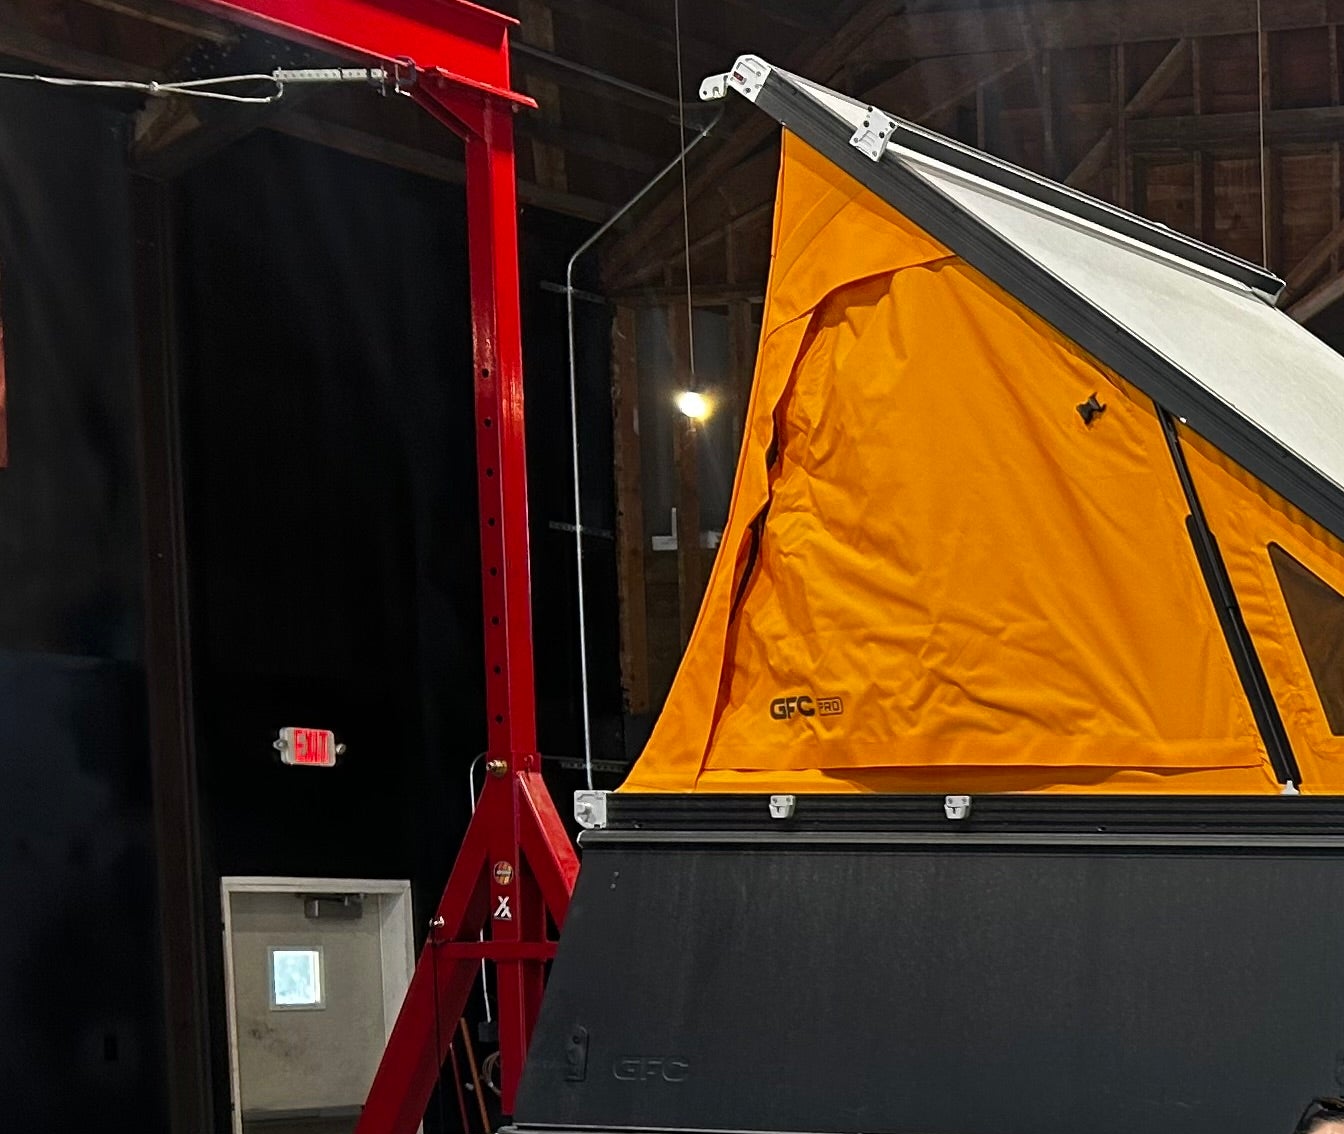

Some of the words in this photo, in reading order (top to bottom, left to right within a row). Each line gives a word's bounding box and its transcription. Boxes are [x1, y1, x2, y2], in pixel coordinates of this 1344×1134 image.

[769, 695, 816, 721] GFC
[818, 699, 842, 715] PRO
[294, 729, 330, 763] EXIT
[612, 1055, 689, 1082] GFC
